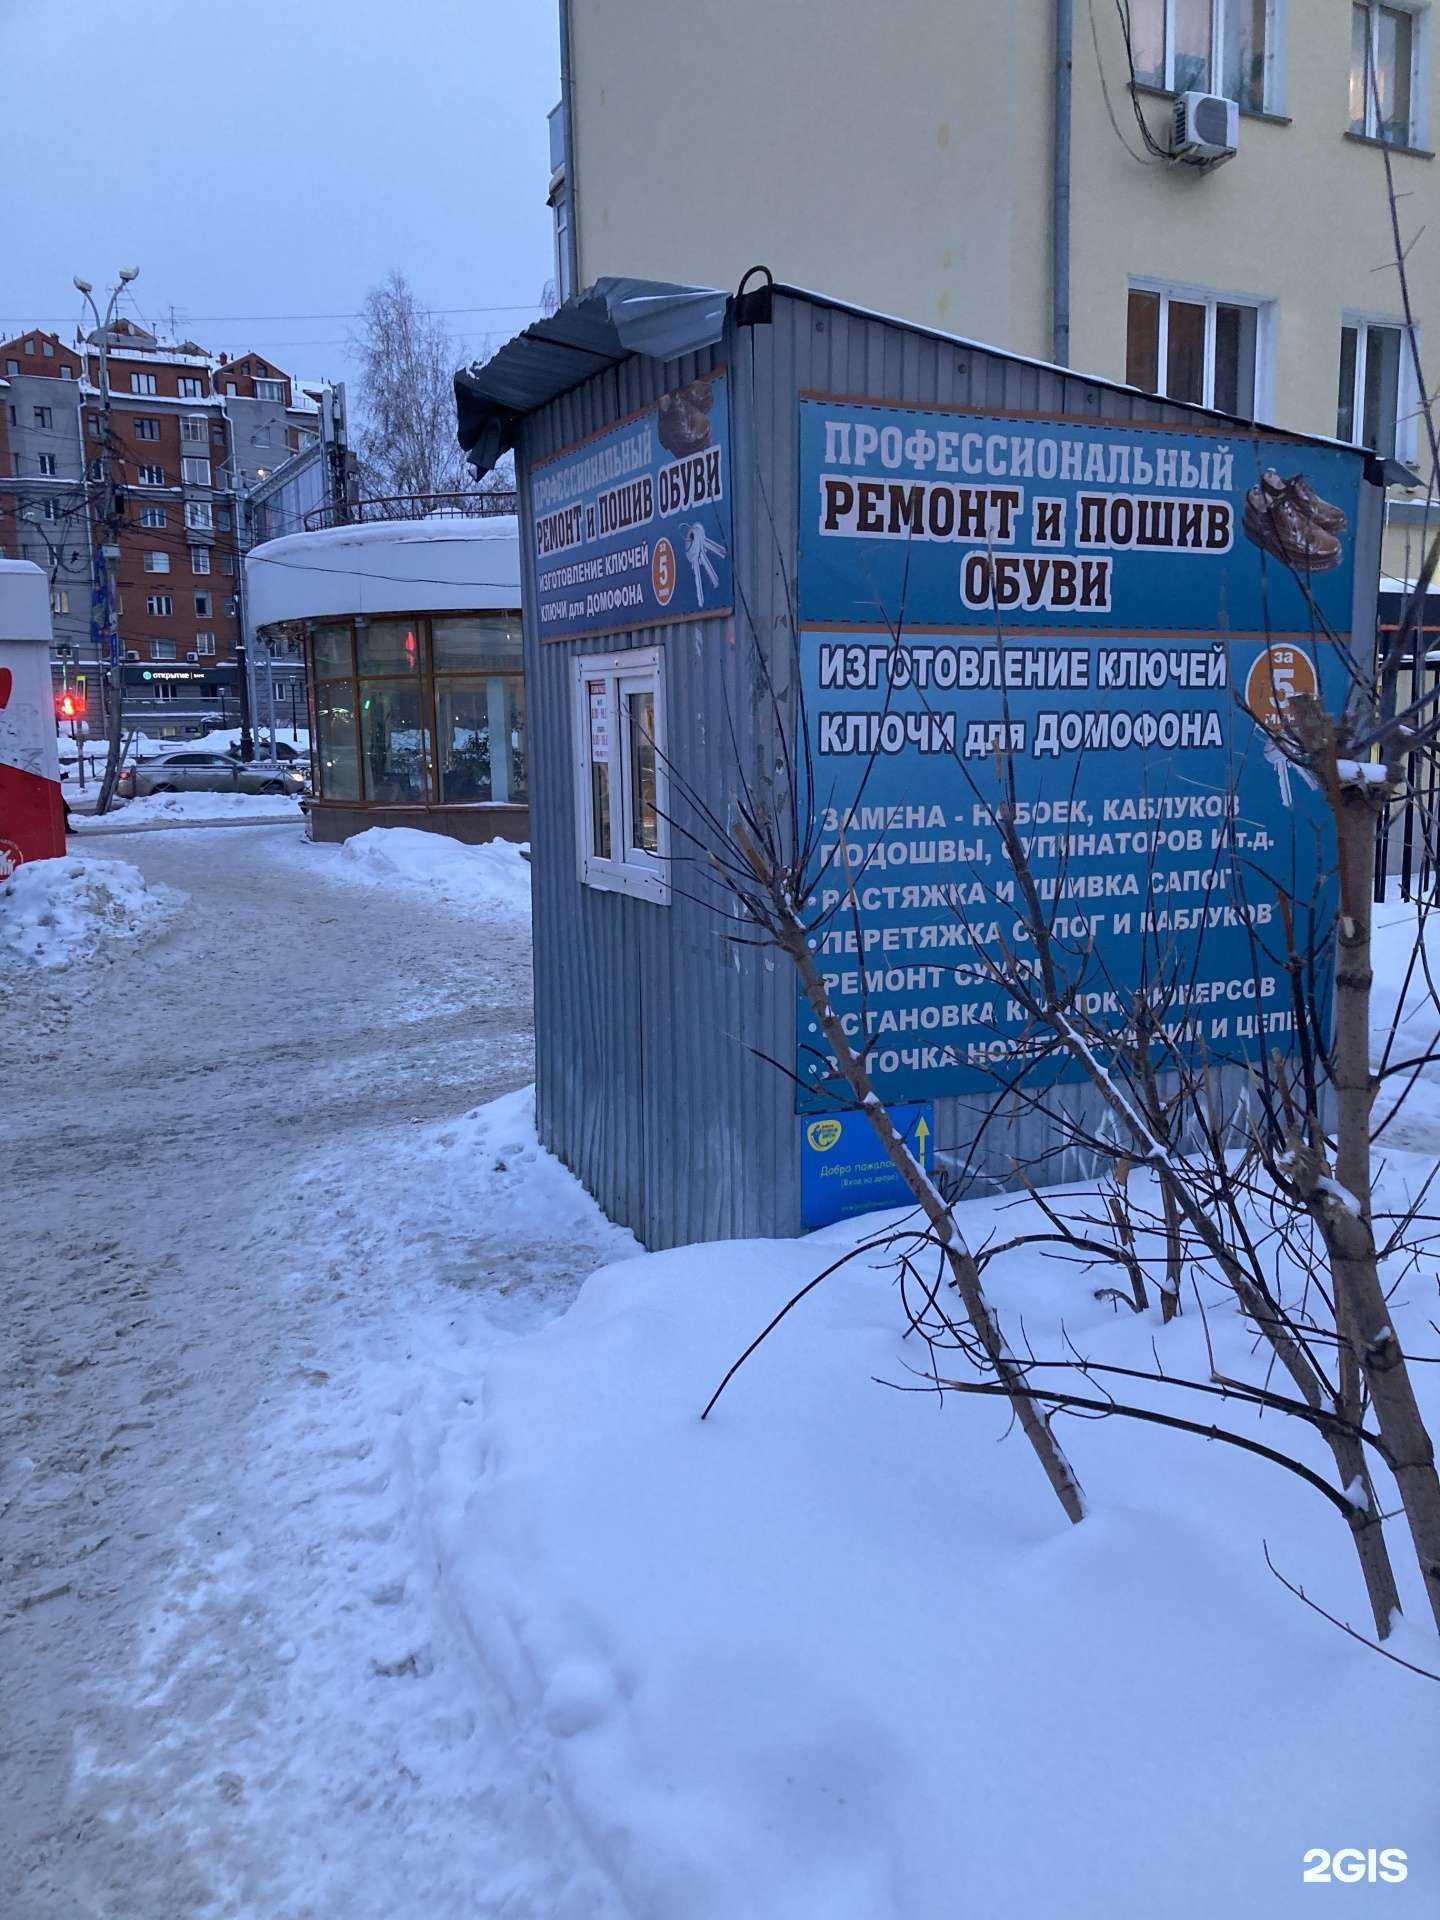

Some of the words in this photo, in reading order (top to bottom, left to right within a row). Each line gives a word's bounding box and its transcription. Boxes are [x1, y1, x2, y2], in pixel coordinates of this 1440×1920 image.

[825, 420, 1233, 492] ПРОФЕССИОНАЛЬНЫЙ
[536, 505, 582, 555] РЕМОНТ
[599, 478, 652, 534] ПОШИВ
[659, 450, 721, 513] ОБУВИ
[823, 479, 1020, 541] РЕМОНТ
[1079, 496, 1232, 550] ПОШИВ
[540, 558, 604, 592] ИЗГОТОВЛЕНИЕ
[605, 541, 648, 575] КЛЮЧЕЙ
[659, 555, 668, 586] 5
[964, 555, 1110, 609] ОБУВИ
[541, 600, 567, 622] КЛЮЧИ
[569, 602, 584, 620] для
[587, 584, 643, 617] ДОМОФОНА
[820, 646, 1089, 689] ИЗГОТОВЛЕНИЕ
[1098, 644, 1227, 688] КЛЮЧЕЙ
[1273, 651, 1295, 664] за
[1269, 668, 1295, 709] 5
[820, 713, 956, 753] КЛЮЧИ
[965, 723, 1025, 758] для
[1034, 711, 1223, 757] ДОМОФОНА
[821, 804, 947, 831] ЗАМЕНА
[972, 800, 1094, 827] НБОЕК,
[1102, 795, 1240, 821] КАБЛУКОВ
[820, 839, 992, 870] ПОДОШВЫ,
[1210, 828, 1228, 850] И
[821, 883, 987, 912] РАСТЯЖКА
[996, 880, 1014, 903] И
[1022, 873, 1140, 901] ШИВКА
[1148, 868, 1232, 894] САПОГ
[821, 921, 1001, 955] ПЕРЕТЯЖКА
[1012, 913, 1105, 942] СПОГ
[1113, 912, 1131, 935] И
[1140, 903, 1273, 933] КАБЛУКОВ
[822, 966, 946, 997] РЕМОНТ
[822, 1002, 998, 1038] СТАНОВКА
[821, 1046, 959, 1079] ЗТОЧКА
[1211, 1017, 1228, 1039] И
[820, 1164, 852, 1178] Добро
